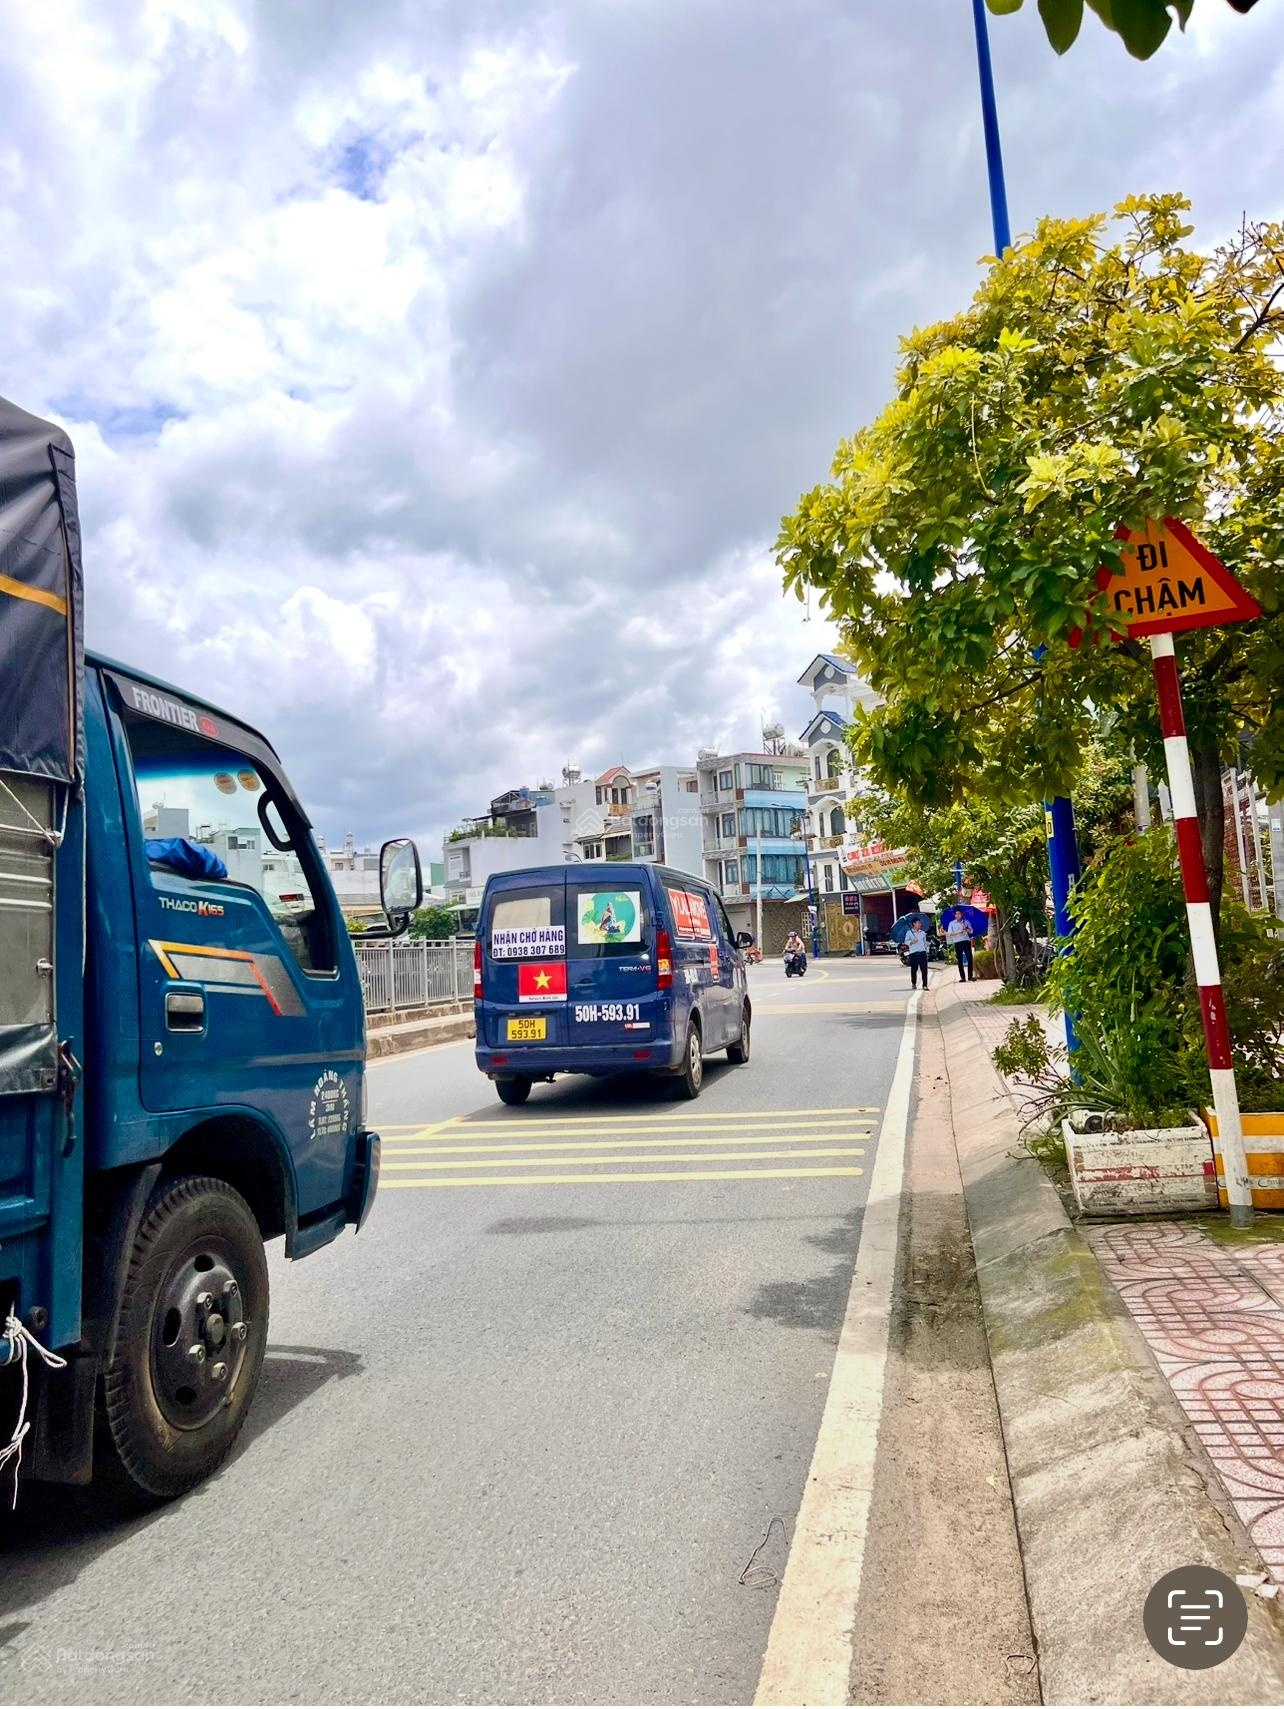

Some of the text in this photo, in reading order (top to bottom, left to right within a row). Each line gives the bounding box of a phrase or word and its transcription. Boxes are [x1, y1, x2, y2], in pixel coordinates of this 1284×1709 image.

[1136, 541, 1168, 572] ĐI
[1114, 577, 1206, 616] CHẬM
[132, 687, 199, 732] FRONTIER
[158, 897, 197, 913] THACO
[494, 928, 564, 947] NHẬN CHỞ HÀNG
[493, 944, 565, 957] ĐT: 0938 307 689
[575, 1003, 640, 1022] 50H-593.91
[518, 1019, 535, 1028] 50H
[511, 1029, 541, 1039] 593.91
